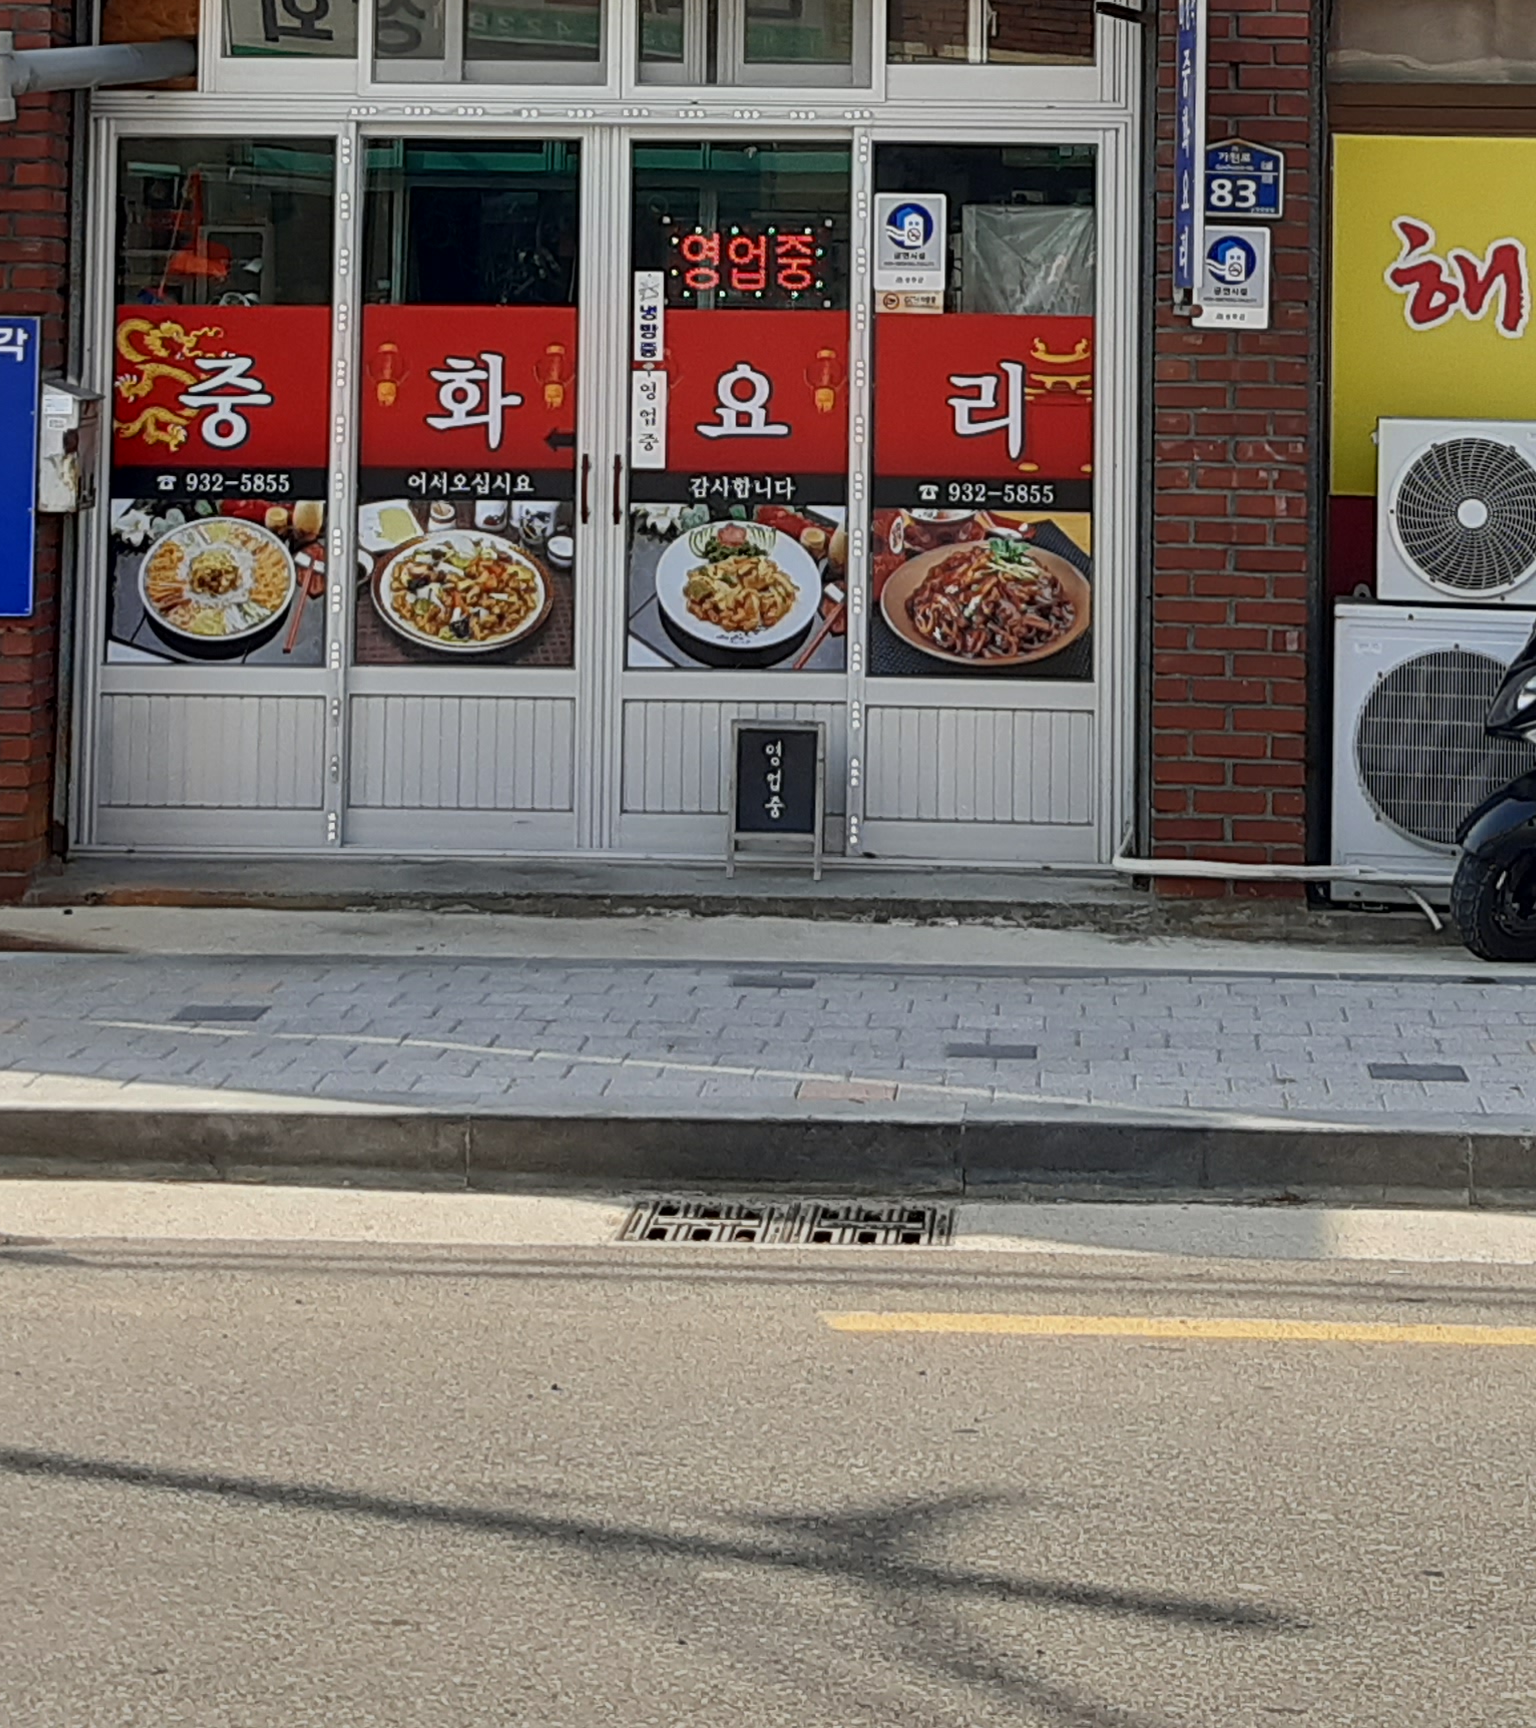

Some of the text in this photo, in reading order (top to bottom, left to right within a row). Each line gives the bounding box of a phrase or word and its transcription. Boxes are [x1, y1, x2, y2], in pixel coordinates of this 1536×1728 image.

[1210, 178, 1257, 208] 83
[682, 233, 813, 290] 영업중
[639, 382, 659, 451] 영업중
[185, 474, 290, 493] 932-5855
[689, 475, 795, 501] 감사합니다
[948, 482, 1054, 505] 932-5855
[765, 740, 785, 819] 영업중
